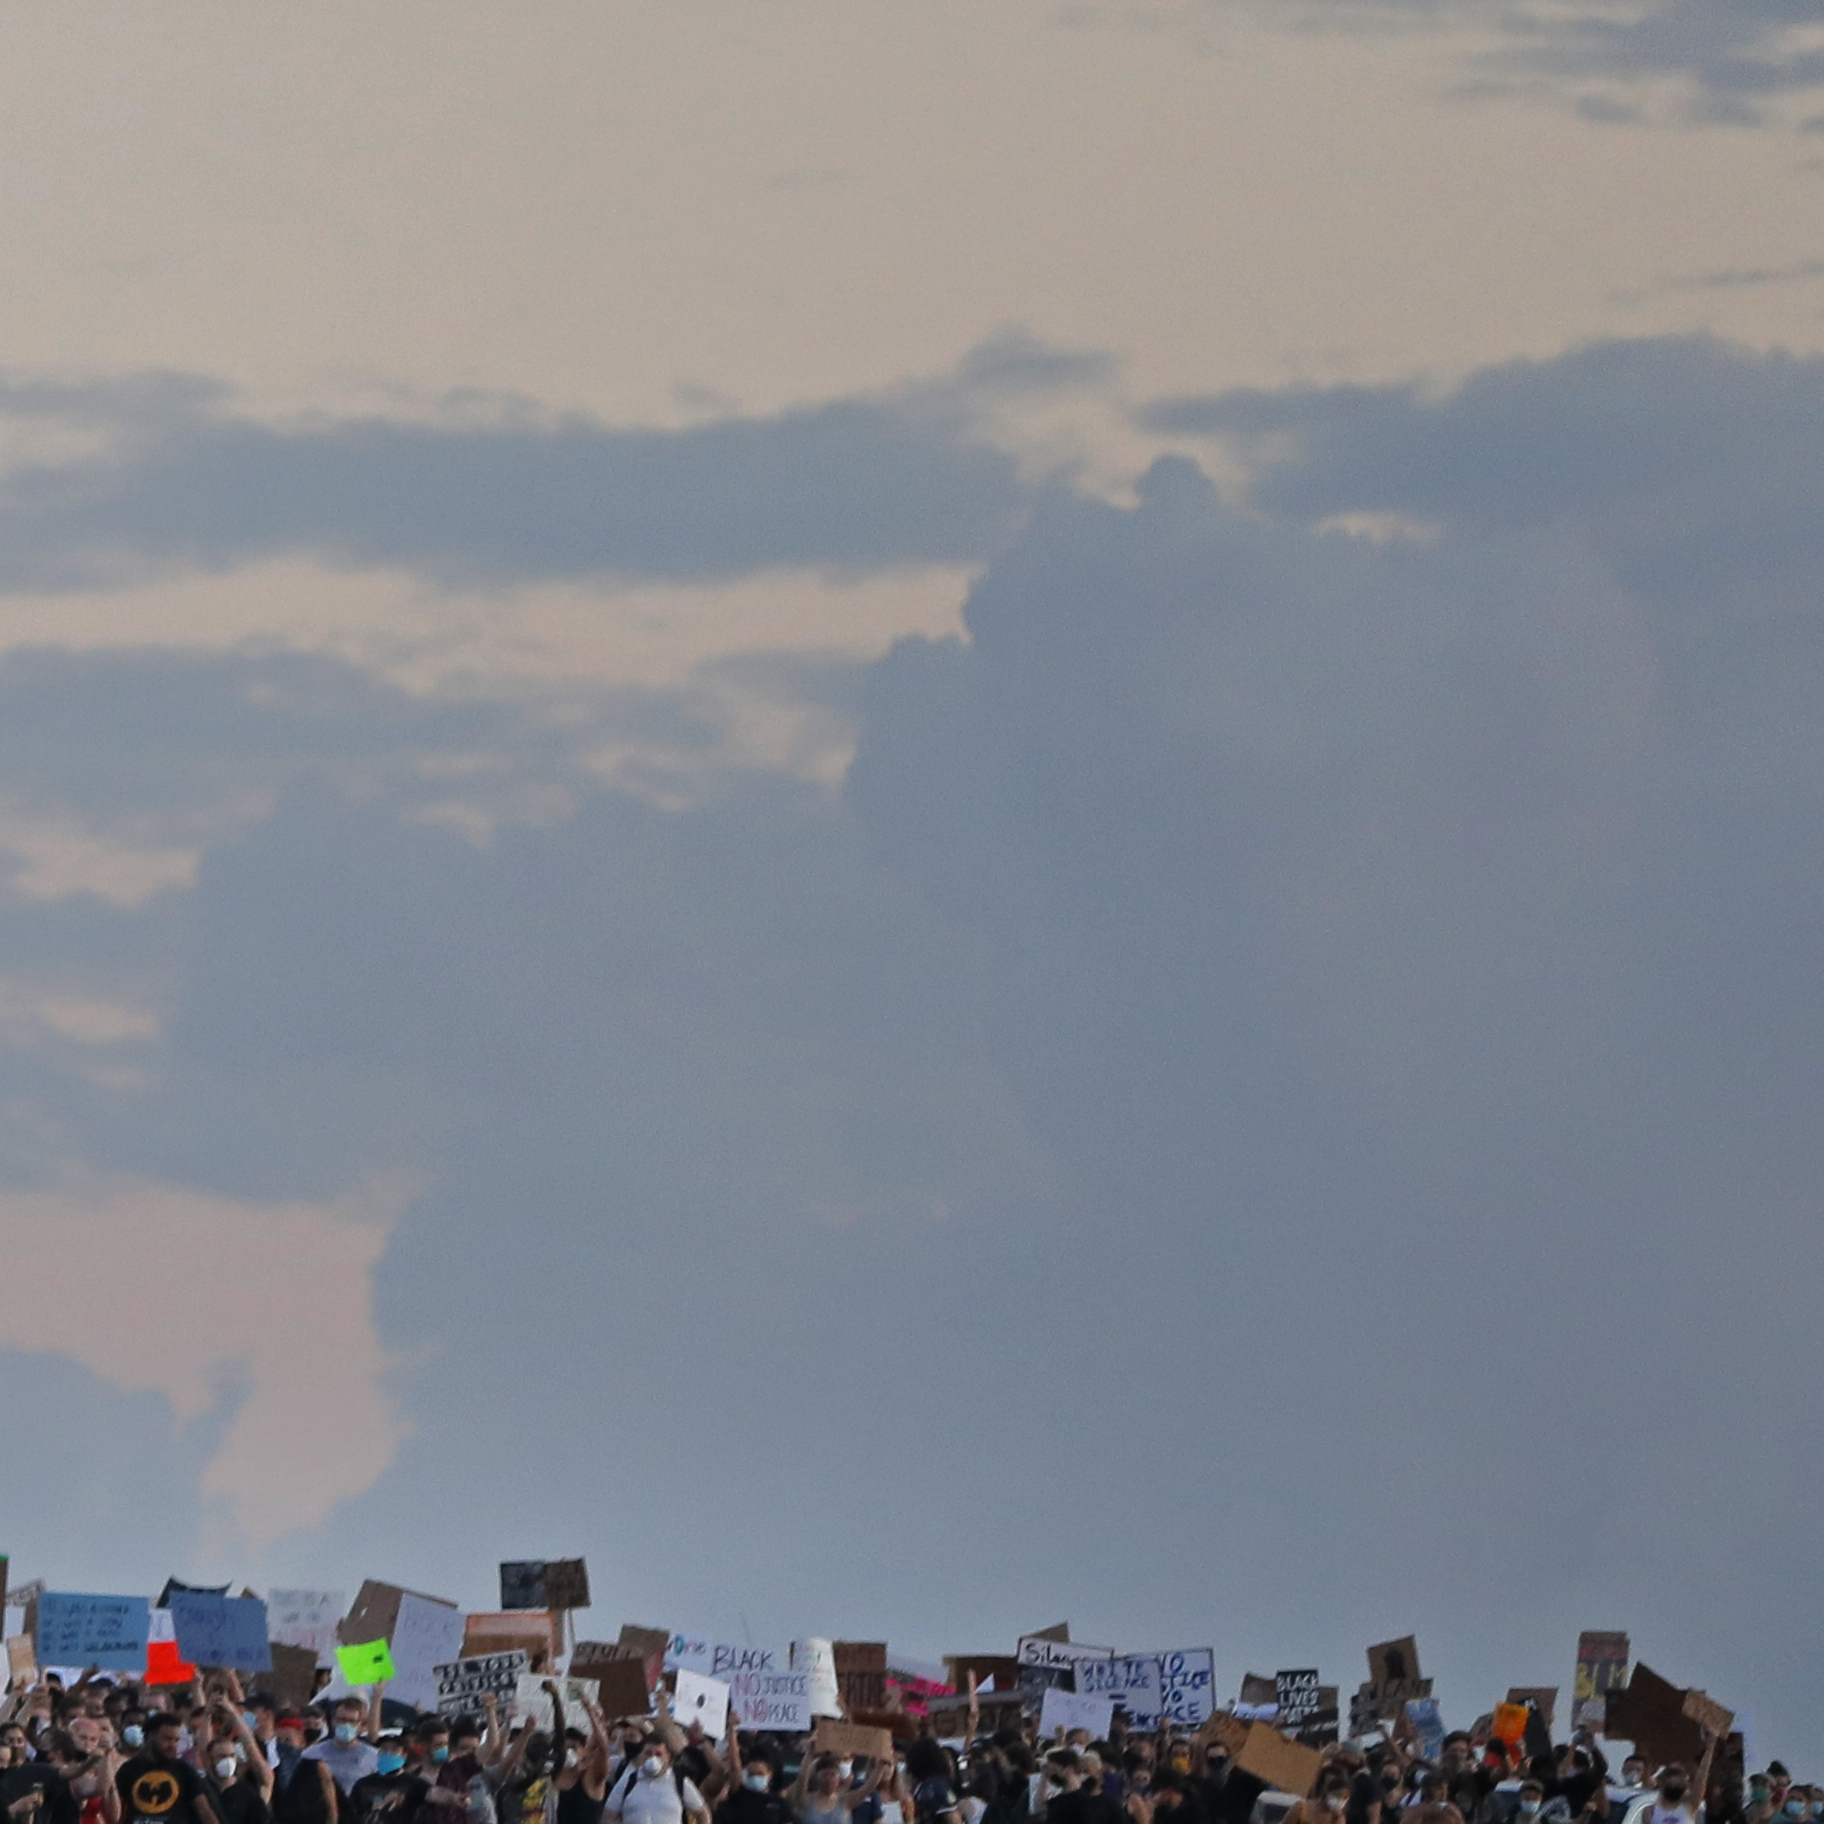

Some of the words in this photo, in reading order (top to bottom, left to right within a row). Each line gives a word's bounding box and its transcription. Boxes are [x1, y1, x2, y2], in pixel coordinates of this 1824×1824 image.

[712, 1645, 773, 1675] BLACK
[1277, 1673, 1318, 1692] BLACK
[1278, 1689, 1318, 1706] LIVES
